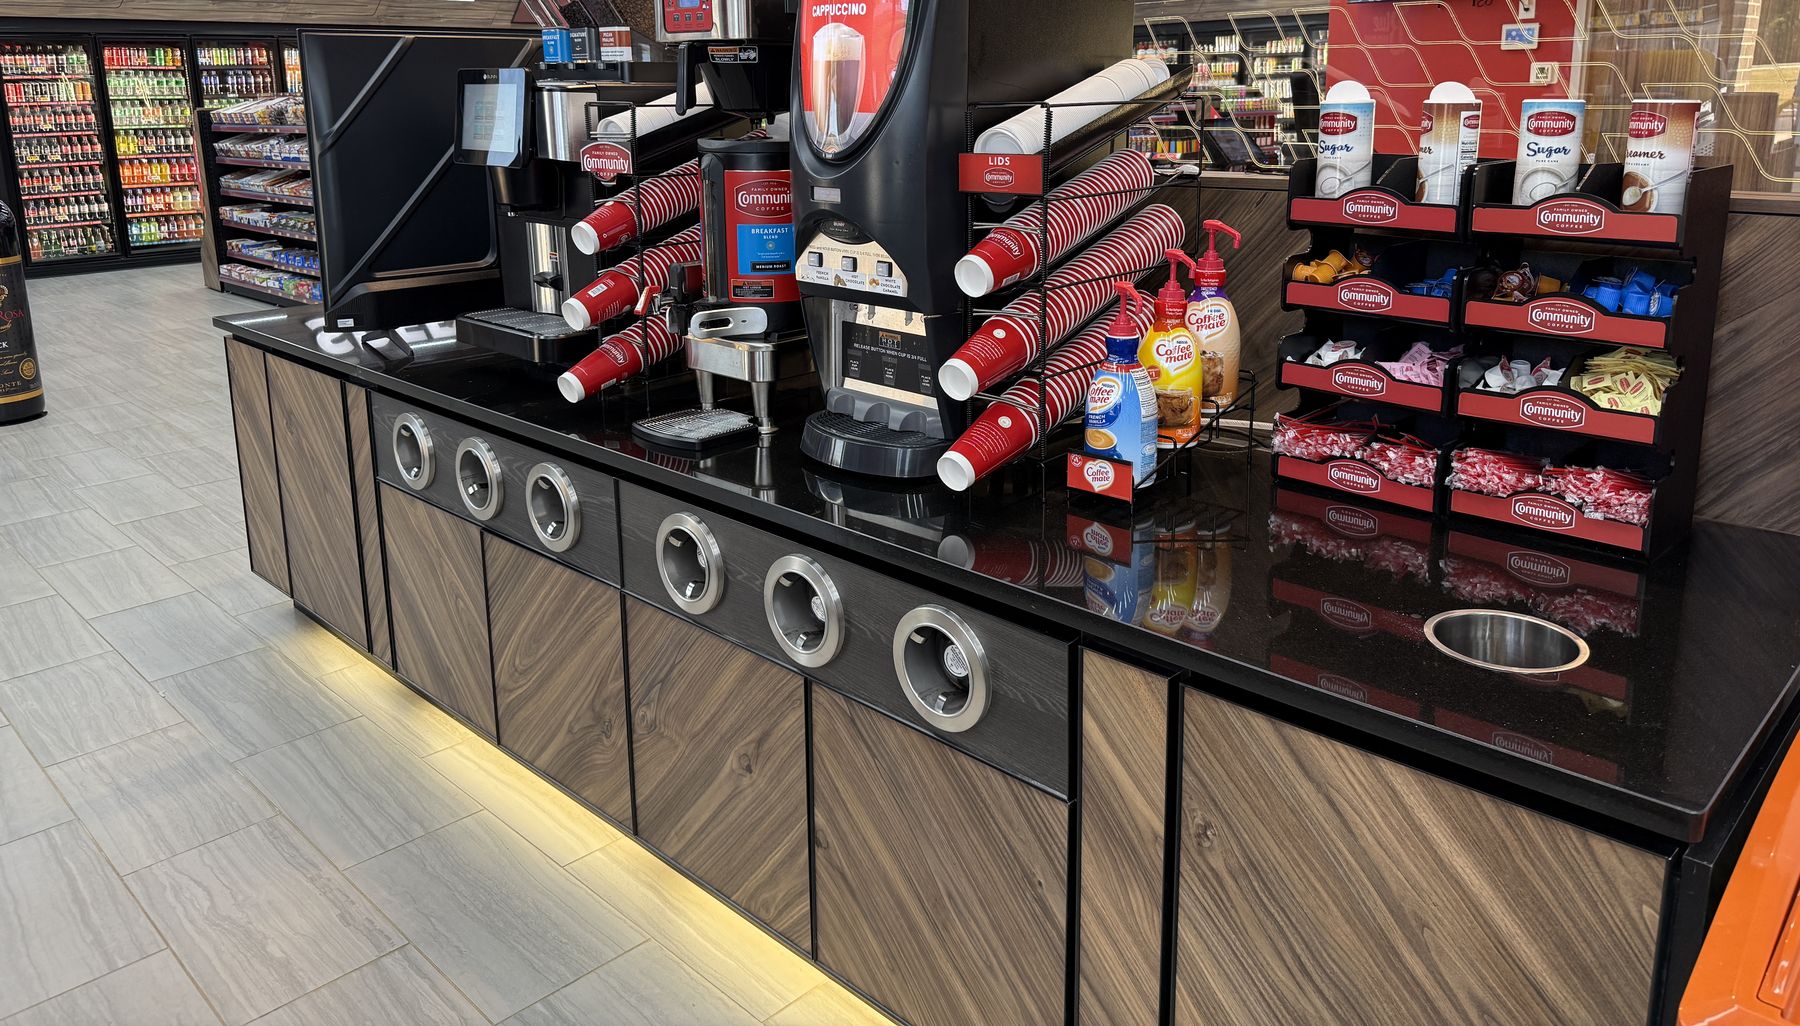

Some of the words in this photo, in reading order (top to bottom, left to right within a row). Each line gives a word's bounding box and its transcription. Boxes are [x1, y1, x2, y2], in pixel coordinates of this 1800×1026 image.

[812, 3, 867, 17] CAPPUCCINO
[1528, 118, 1575, 130] Community
[1319, 140, 1354, 155] Sugar
[1526, 141, 1571, 158] Sugar
[988, 156, 1010, 165] LIDS
[1626, 149, 1666, 160] reamer
[584, 154, 629, 174] Community
[985, 173, 1012, 183] Community
[738, 191, 792, 207] Communi
[1346, 201, 1395, 216] Community
[1540, 210, 1600, 226] Community
[1341, 289, 1389, 306] Community
[1188, 313, 1225, 325] Coffee
[1532, 308, 1591, 327] Community
[1196, 320, 1226, 331] mate
[853, 343, 870, 351] RELEASE
[882, 337, 897, 345] HOT
[1156, 344, 1192, 356] Coffee
[1165, 352, 1193, 363] mate
[1335, 372, 1383, 391] Community
[1523, 402, 1581, 423] Community
[1538, 416, 1564, 424] COFFEE
[1086, 466, 1110, 477] Coffee
[1330, 467, 1378, 488] Community
[1515, 501, 1572, 524] Community
[1529, 516, 1555, 525] COFFEE
